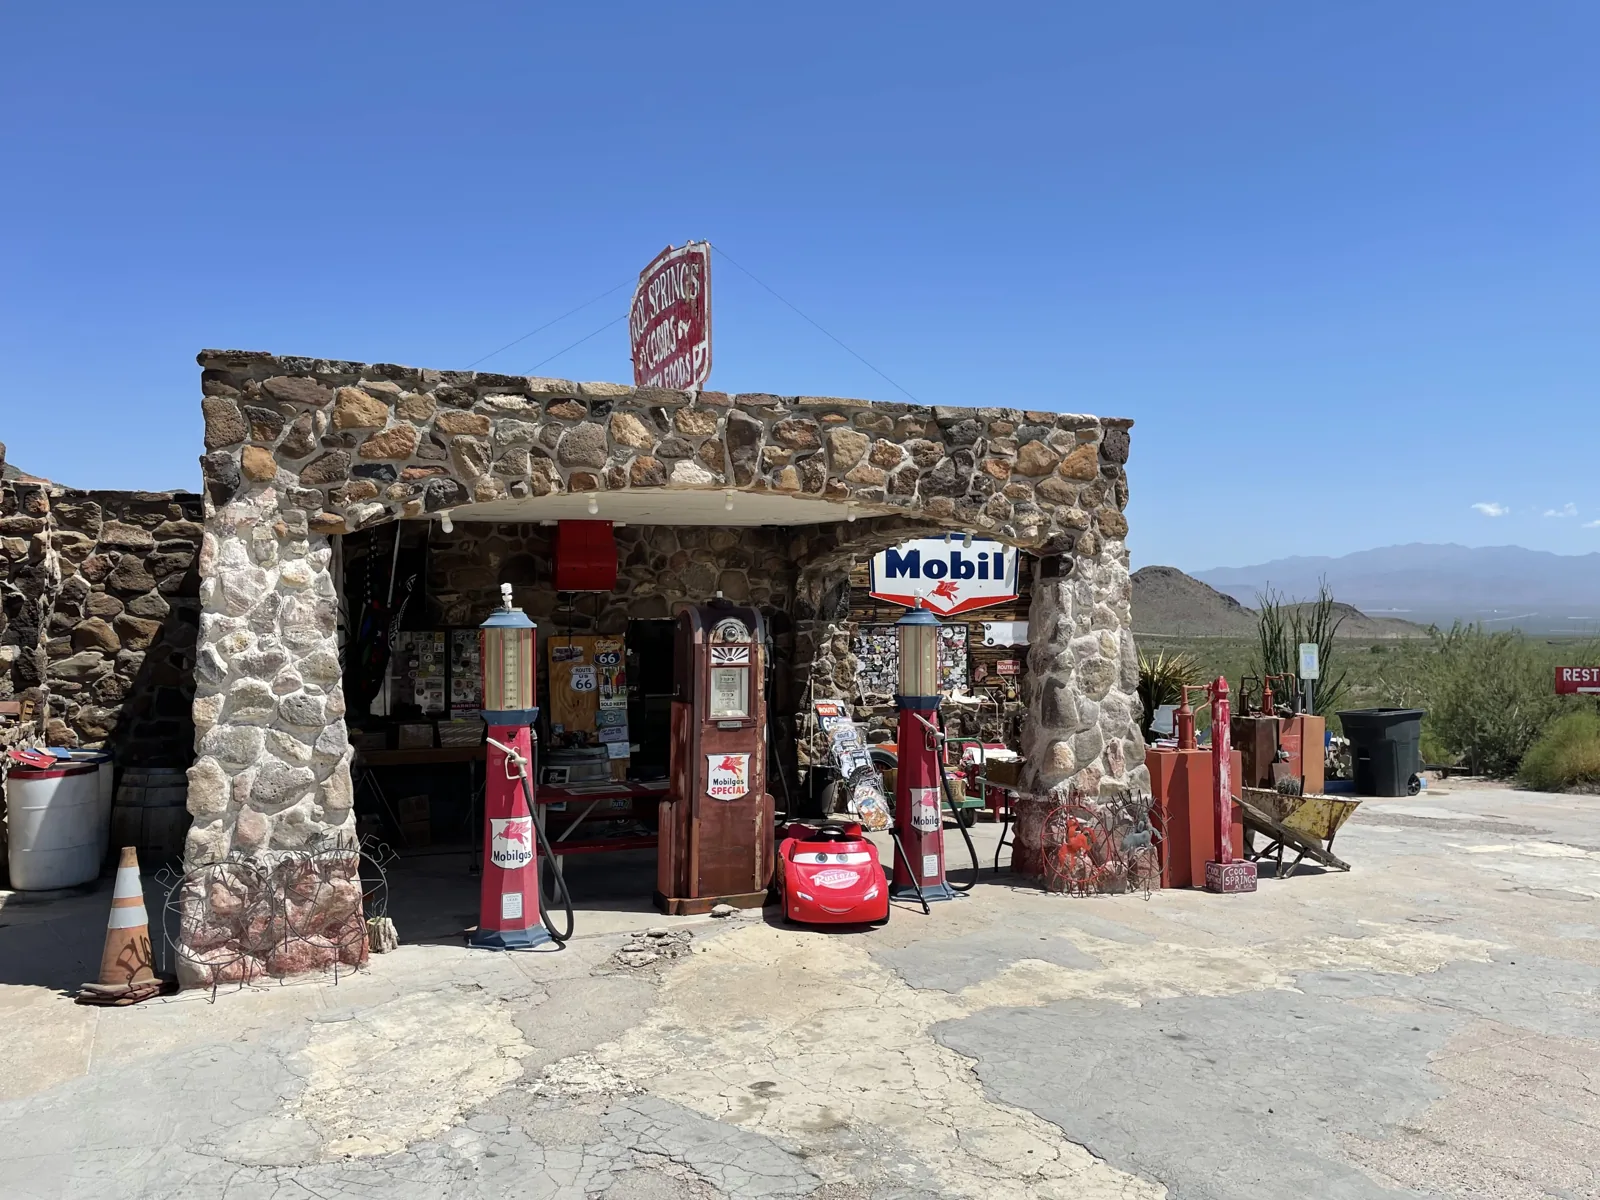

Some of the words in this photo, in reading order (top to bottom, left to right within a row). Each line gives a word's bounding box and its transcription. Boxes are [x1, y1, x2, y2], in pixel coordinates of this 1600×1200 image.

[648, 262, 700, 319] SPRINGS
[663, 352, 691, 389] FOODS
[885, 549, 1005, 580] Mobil
[600, 653, 616, 664] 66
[1562, 668, 1600, 682] REST
[575, 679, 592, 690] 66
[819, 706, 837, 714] ROUTE
[713, 778, 744, 787] Mobilgas
[711, 786, 746, 795] SPECIAL
[493, 850, 532, 863] Mobilgas
[1228, 867, 1248, 877] COOL
[1225, 874, 1256, 886] SPRINGS
